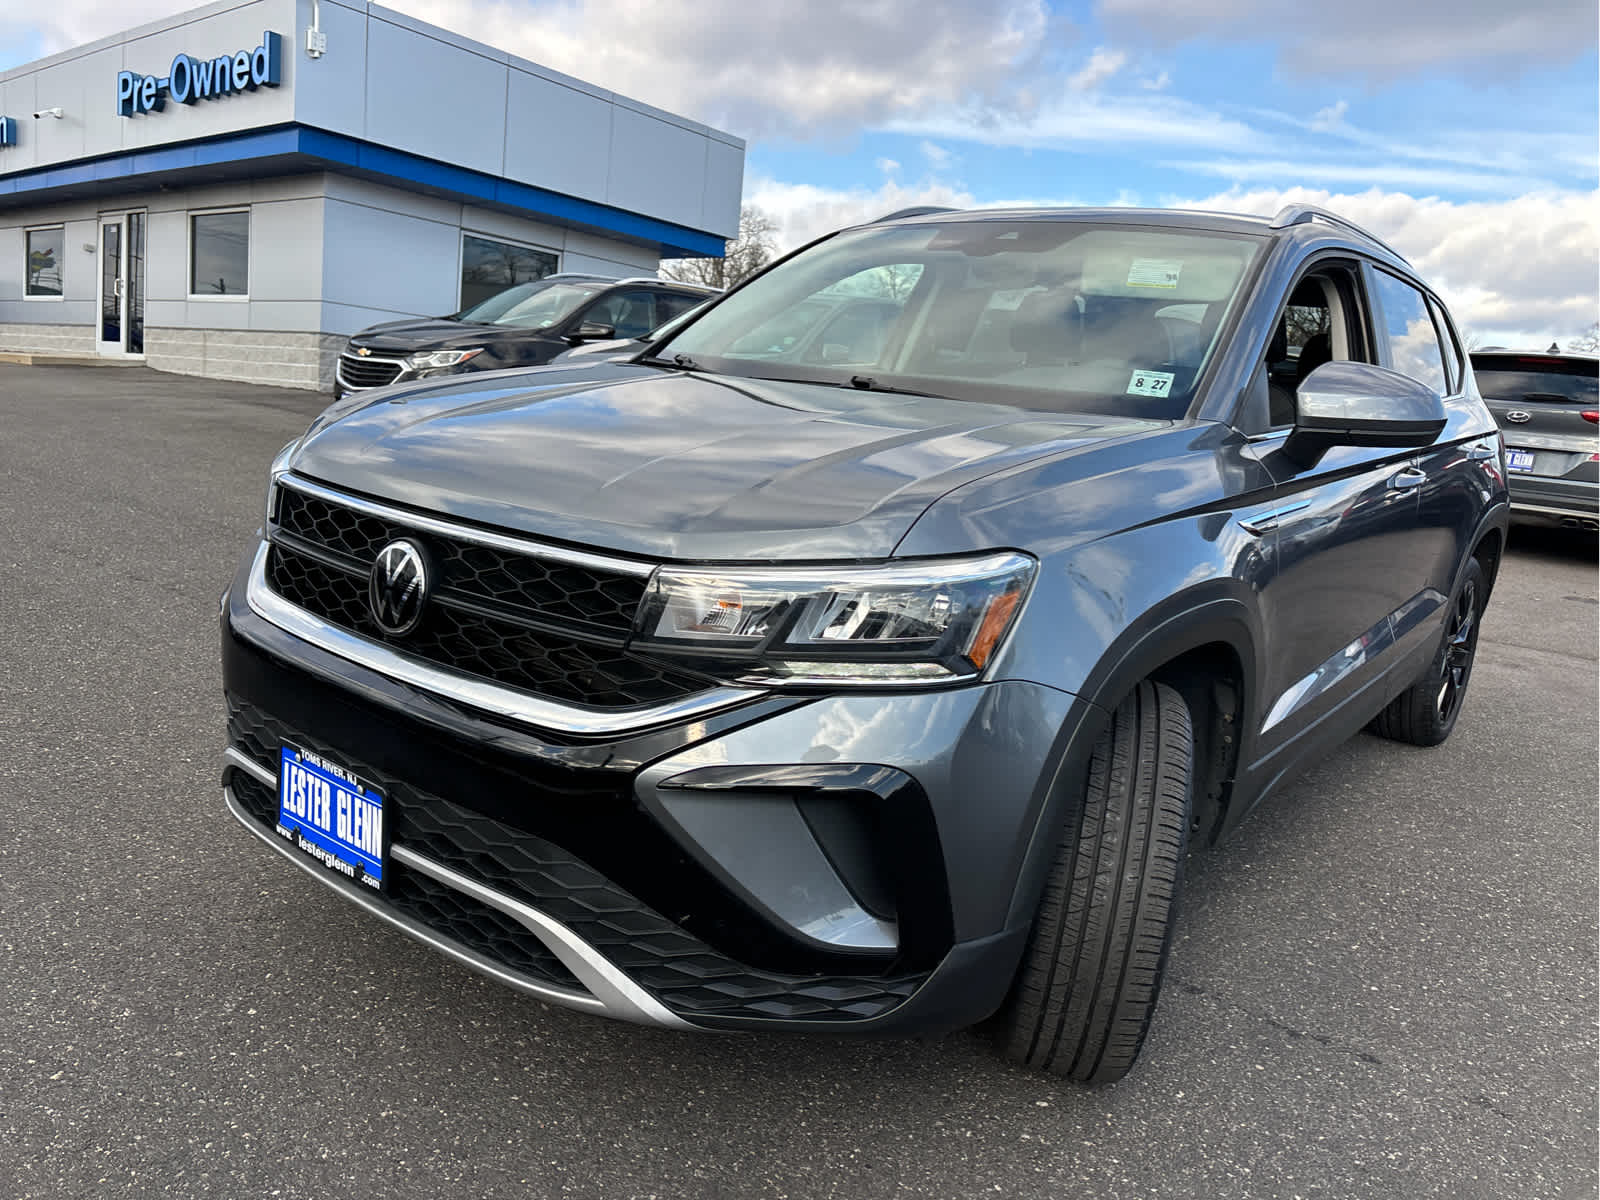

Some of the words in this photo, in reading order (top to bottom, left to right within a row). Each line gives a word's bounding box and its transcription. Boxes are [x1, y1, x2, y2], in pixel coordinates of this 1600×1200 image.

[117, 30, 281, 118] Pre-Owned
[1135, 378, 1145, 387] 8
[1151, 379, 1168, 390] 27
[300, 748, 321, 767] TOMS
[322, 759, 346, 779] RIVER,
[347, 772, 357, 786] NJ
[283, 761, 331, 832] LESTER
[337, 789, 382, 860] GLENN
[299, 834, 354, 877] lesterglenn
[361, 874, 380, 889] .com
